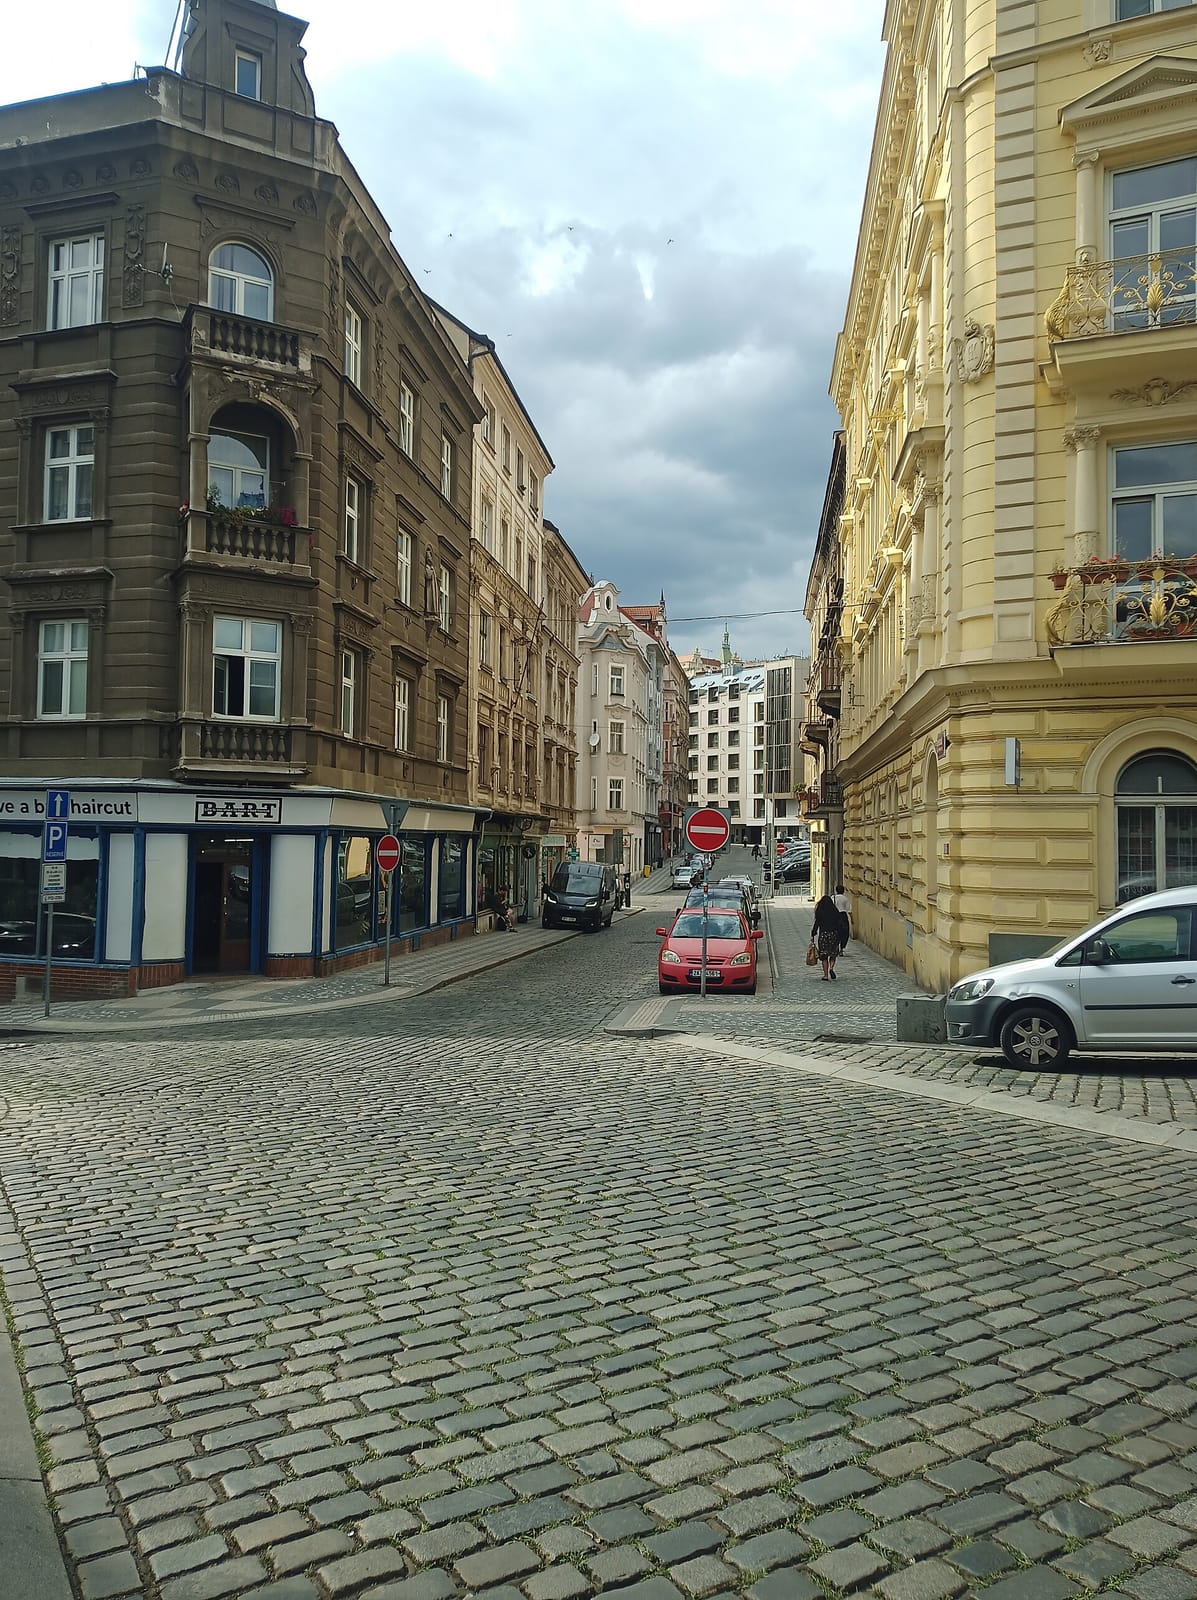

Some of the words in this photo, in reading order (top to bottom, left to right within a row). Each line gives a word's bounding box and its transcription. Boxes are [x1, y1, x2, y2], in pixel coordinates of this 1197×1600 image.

[20, 802, 29, 813] a
[70, 798, 132, 815] haircut
[201, 801, 276, 818] BART
[49, 826, 62, 849] P
